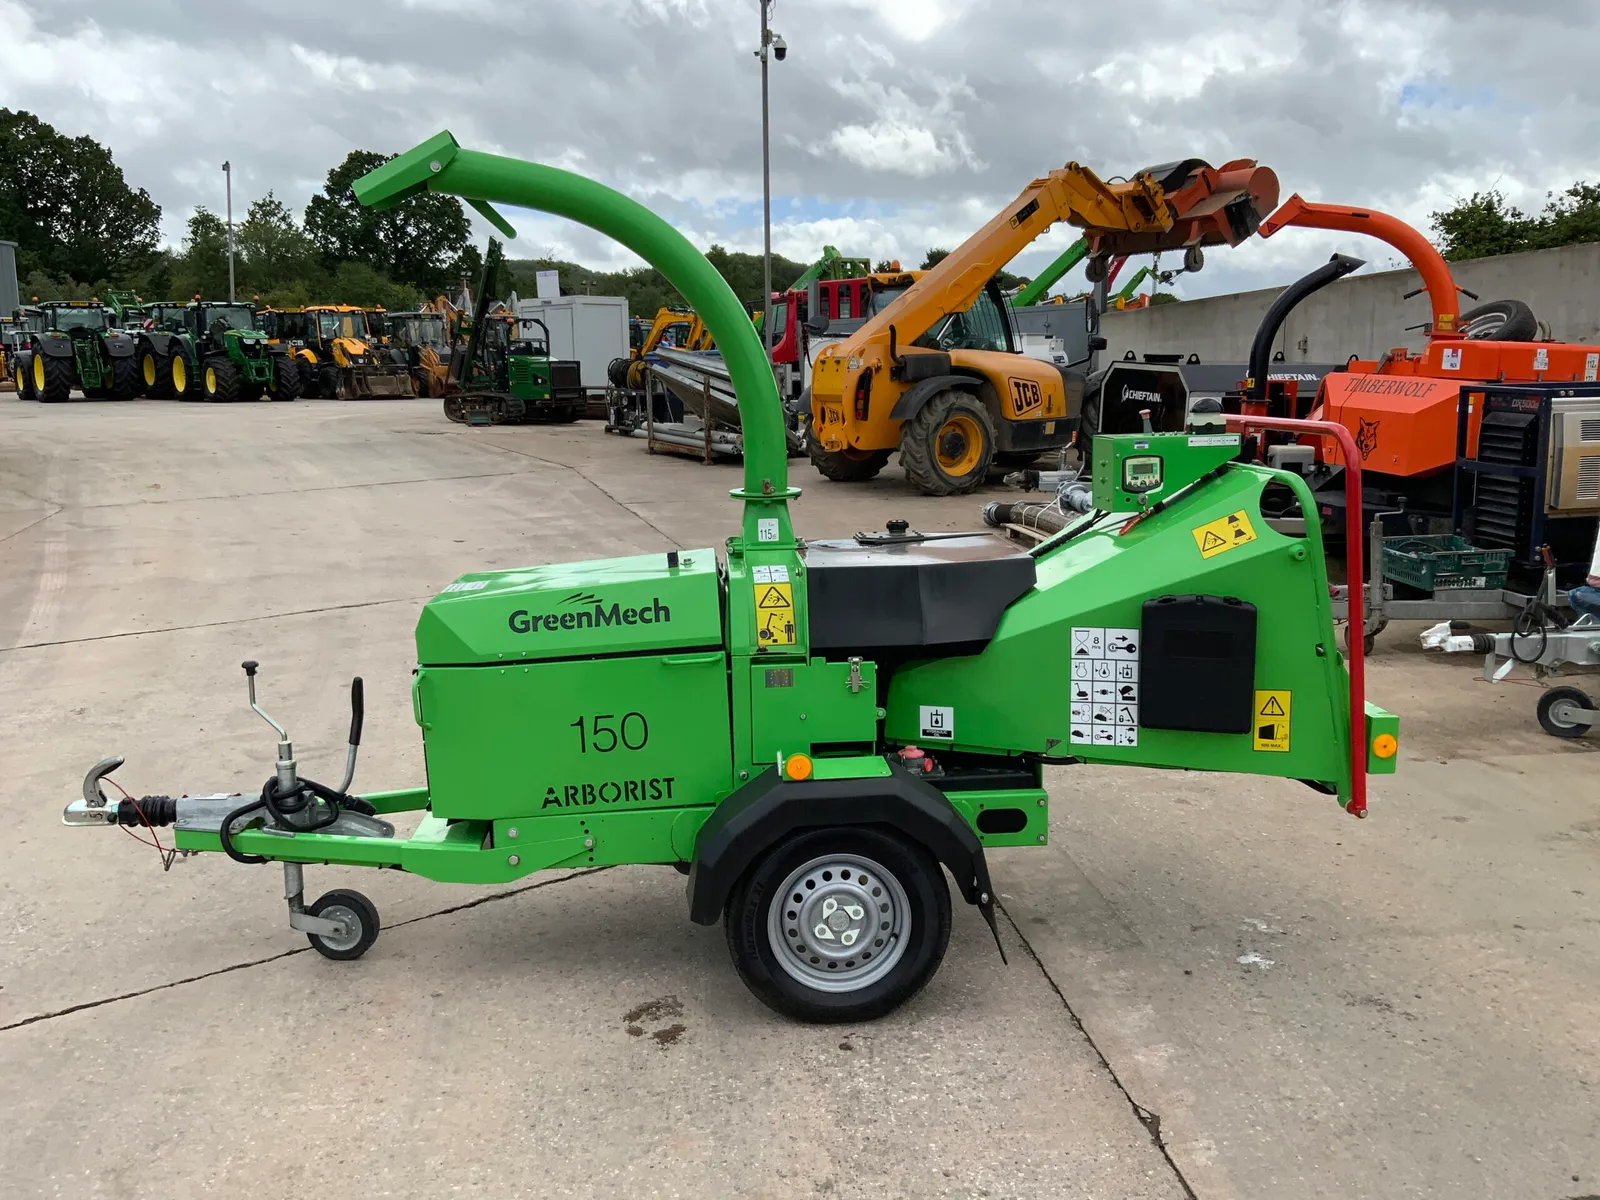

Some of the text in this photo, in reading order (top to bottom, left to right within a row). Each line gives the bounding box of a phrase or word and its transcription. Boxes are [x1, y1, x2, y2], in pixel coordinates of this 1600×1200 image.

[1267, 373, 1318, 381] HIEFTAIN
[1013, 381, 1040, 412] JCB
[1129, 390, 1161, 402] CHIEFTAIN
[1344, 378, 1437, 398] TIMBERWOLF
[759, 529, 773, 540] 115
[508, 598, 671, 634] GreenMech
[1093, 637, 1100, 645] 8
[570, 712, 649, 754] 150
[541, 777, 675, 809] ARBORIST
